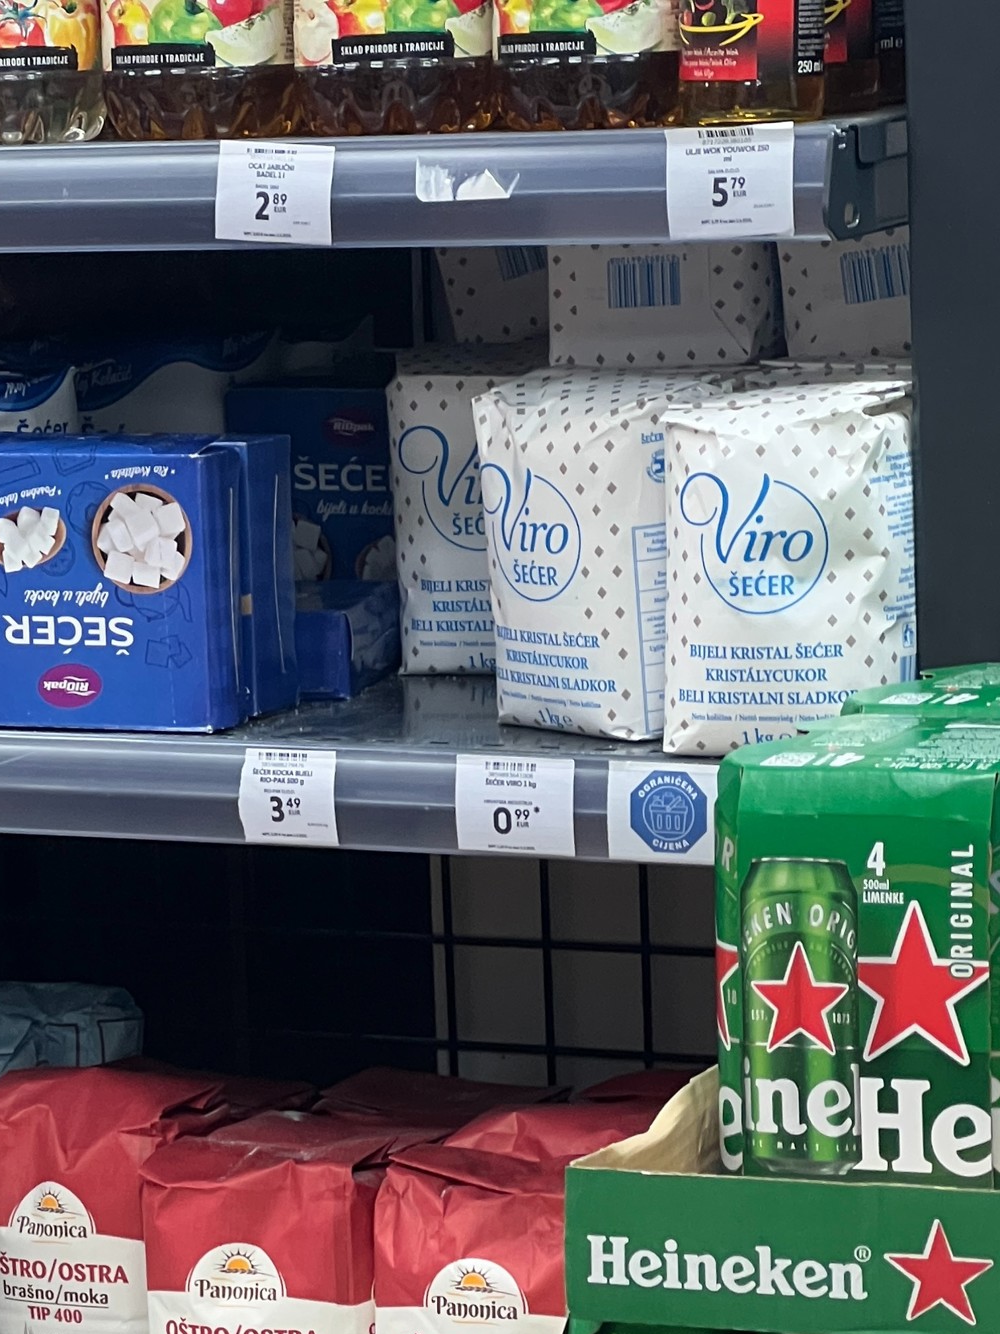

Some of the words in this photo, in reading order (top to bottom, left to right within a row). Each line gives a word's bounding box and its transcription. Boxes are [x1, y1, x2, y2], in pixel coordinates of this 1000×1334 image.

[33, 57, 68, 66] TRADICIJE
[722, 145, 755, 153] YOUWOK
[711, 177, 728, 207] 5
[731, 177, 745, 189] 79
[732, 190, 747, 198] EUR
[255, 191, 270, 220] 2
[273, 194, 287, 204] 89
[680, 472, 814, 564] Viro
[513, 560, 558, 587] ŠEĆER
[729, 569, 794, 597] ŠEĆER
[24, 589, 60, 607] kocki
[63, 591, 72, 601] u
[76, 582, 109, 607] bijeli
[4, 615, 134, 656] ŠEĆER
[520, 631, 562, 647] KRISTAL
[563, 632, 600, 649] ŠEĆER
[506, 649, 589, 670] KRISTÁLYCUKOR
[690, 644, 727, 658] BIJELI
[731, 646, 793, 661] KRISTAL
[795, 642, 844, 659] ŠEĆER
[510, 671, 560, 690] KRISTALNI
[562, 676, 617, 693] SLADKOR
[706, 665, 828, 683] KRISTÁLYCUKOR
[638, 774, 699, 801] OGRANIČENA
[270, 796, 285, 823] 3
[286, 798, 300, 808] 49
[493, 807, 511, 834] 0
[515, 809, 530, 820] 99
[651, 837, 691, 853] CIJENA
[867, 841, 887, 876] 4
[863, 879, 889, 890] 500ml
[863, 892, 904, 905] LIMENKE
[951, 843, 974, 979] ORIGINAL
[17, 1214, 88, 1240] Panonica
[586, 1234, 868, 1300] Heineken
[3, 1280, 109, 1306] brašno/moka
[195, 1279, 278, 1303] Panonica
[28, 1306, 50, 1321] TIP
[53, 1308, 83, 1324] 400
[430, 1295, 518, 1321] Panonica
